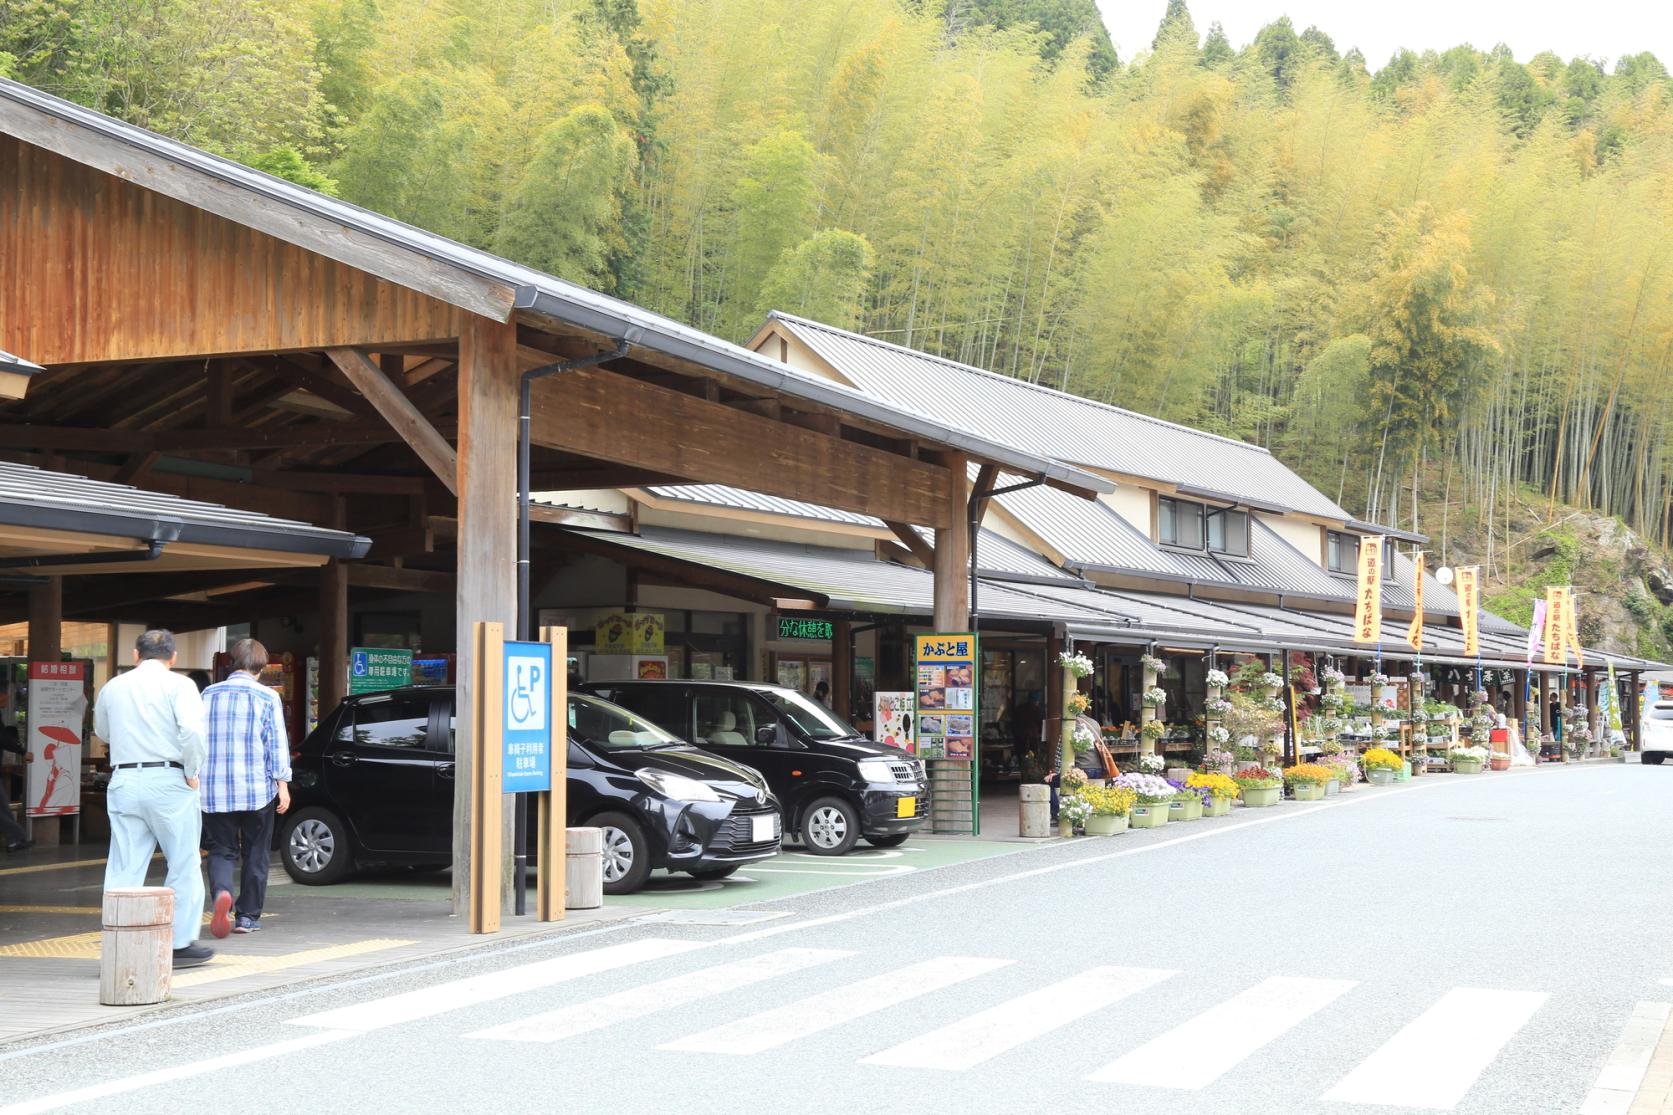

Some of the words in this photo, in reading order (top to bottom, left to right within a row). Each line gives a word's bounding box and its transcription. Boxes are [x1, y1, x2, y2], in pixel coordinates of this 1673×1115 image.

[923, 642, 968, 656] かぶと屋
[530, 665, 541, 692] P
